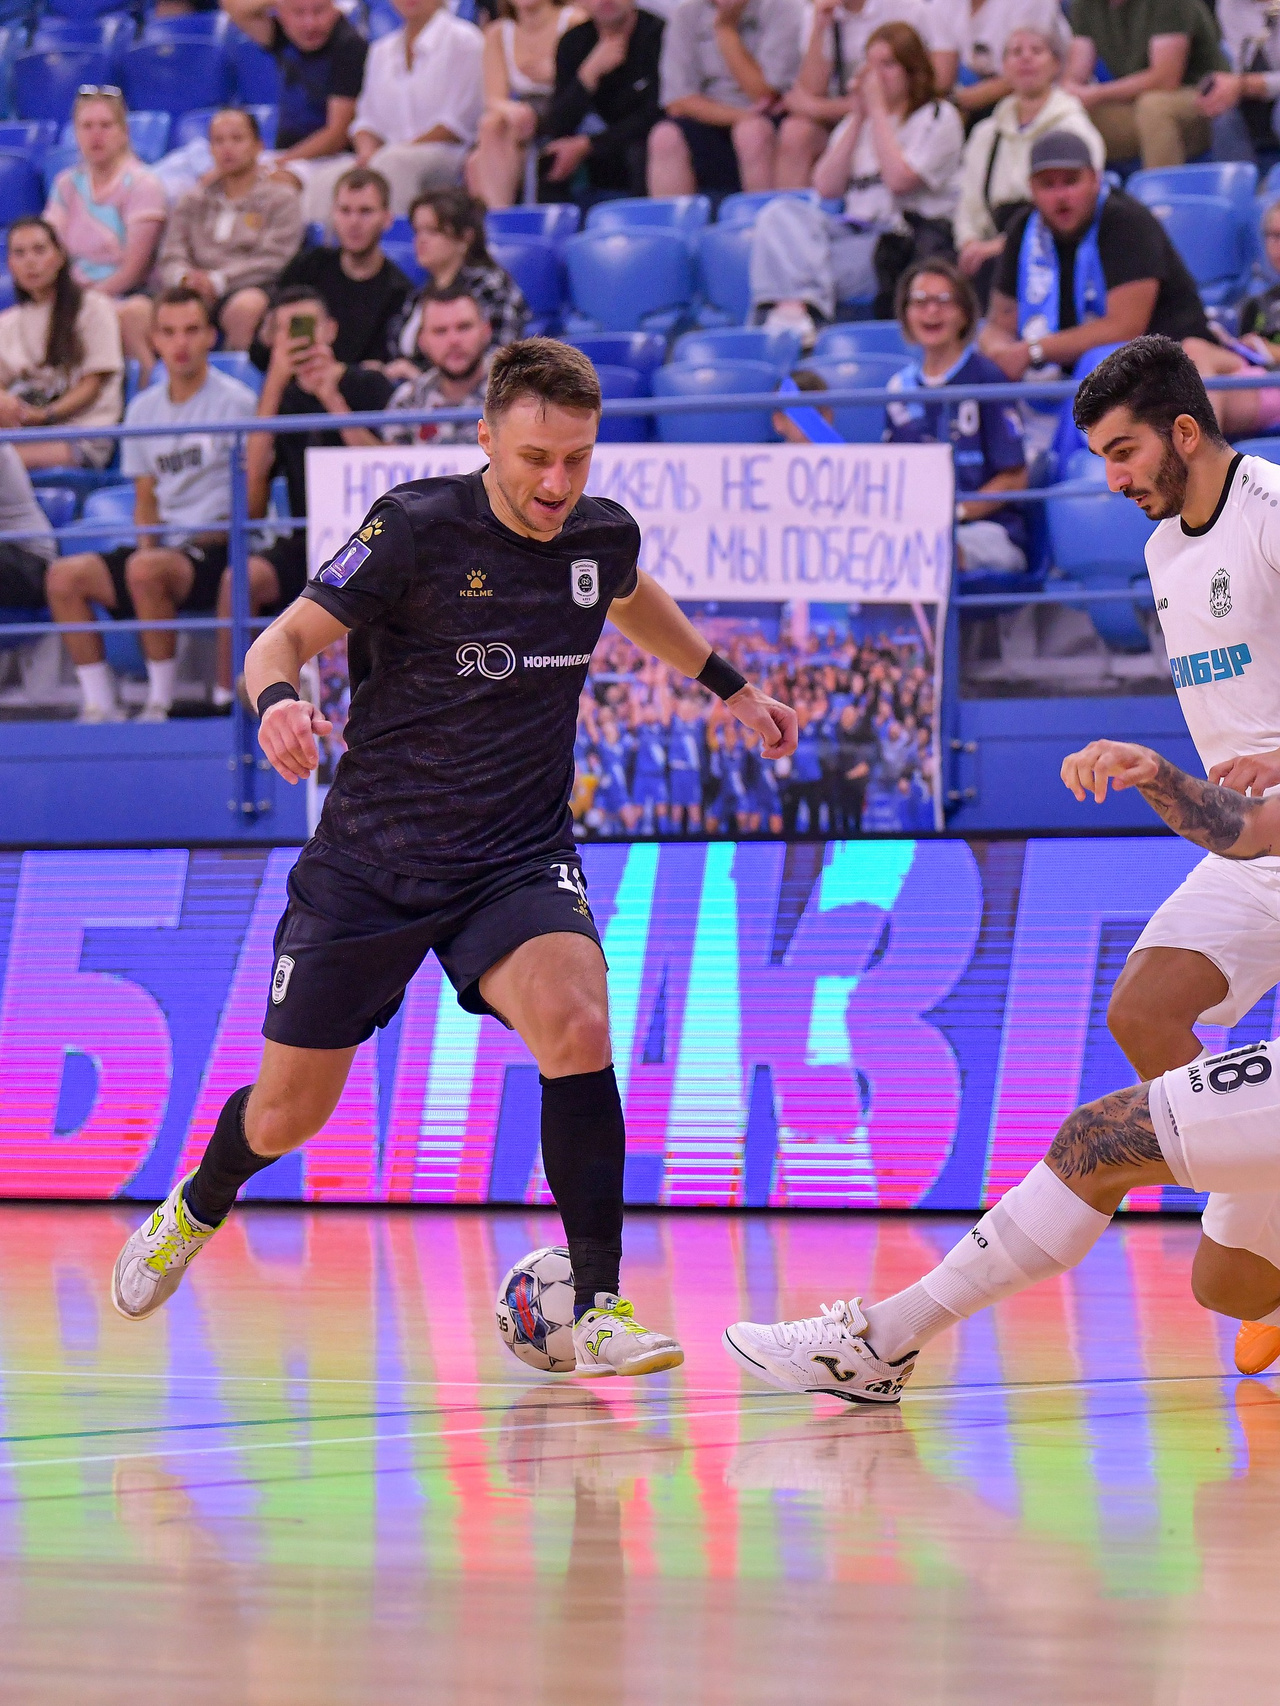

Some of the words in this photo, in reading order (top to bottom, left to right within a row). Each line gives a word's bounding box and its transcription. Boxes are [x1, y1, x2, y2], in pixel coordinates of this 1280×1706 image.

[585, 459, 700, 512] ИКЕЛЬ
[722, 456, 772, 511] НЕ
[706, 524, 768, 582] МЫ
[459, 589, 494, 598] KELME
[523, 653, 591, 668] НОРНИКЕЛ
[1169, 643, 1252, 689] СИБУР
[1187, 1064, 1204, 1094] JAKO
[1203, 1044, 1273, 1095] 18
[971, 1226, 989, 1249] KO
